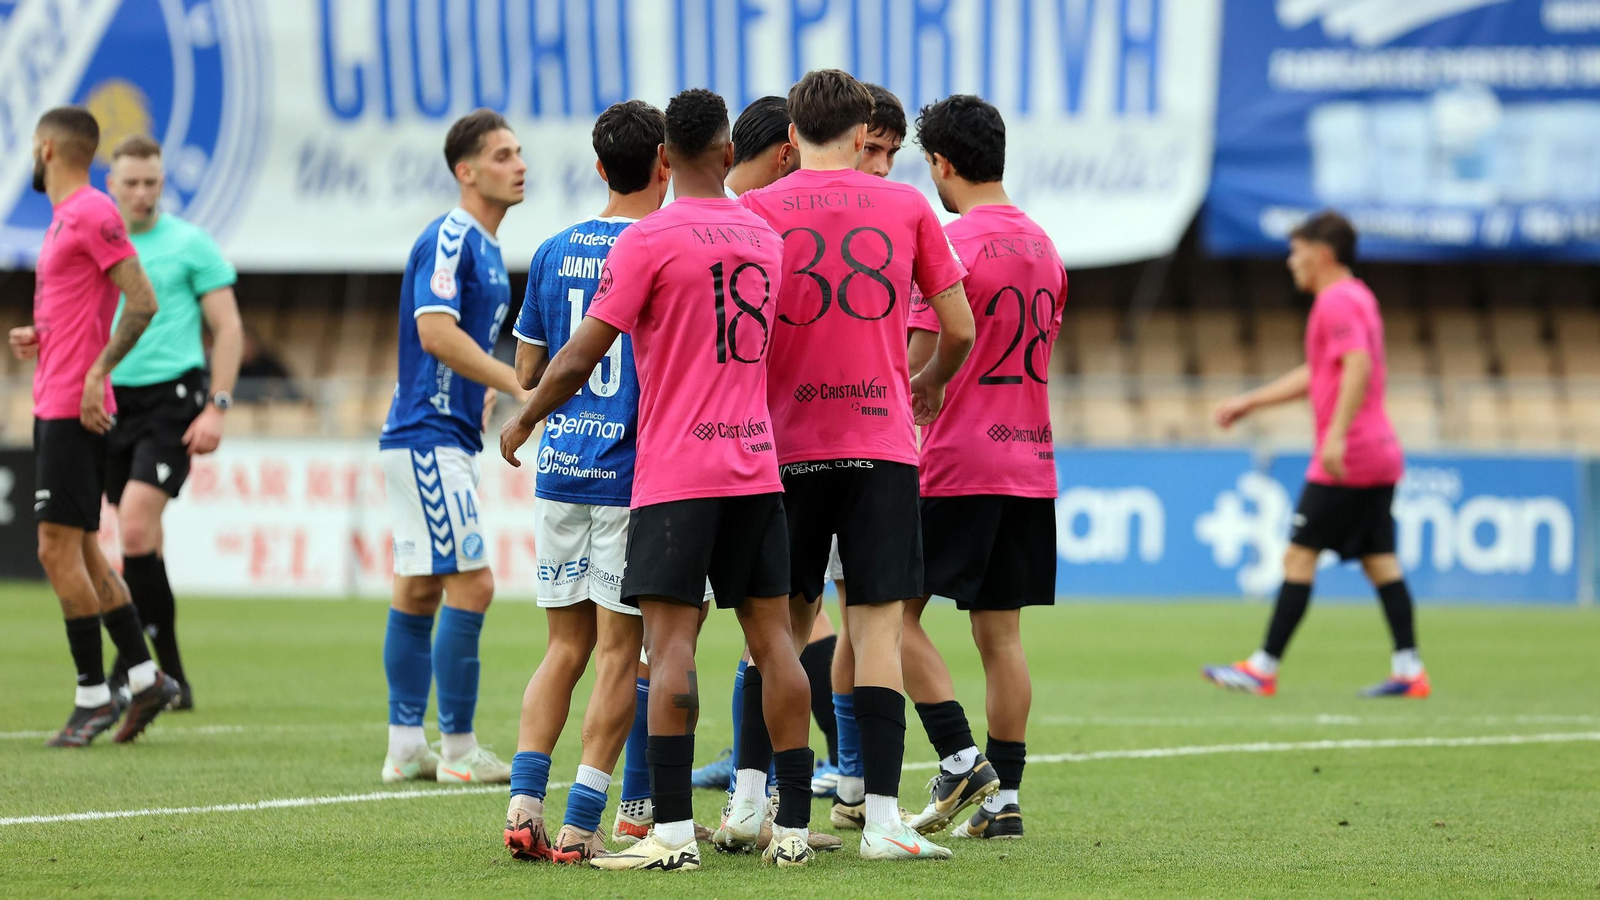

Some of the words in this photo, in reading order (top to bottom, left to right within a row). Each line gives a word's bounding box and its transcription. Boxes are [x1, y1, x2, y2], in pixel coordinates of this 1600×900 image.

[782, 192, 849, 211] SERGI
[778, 226, 897, 326] 38
[708, 261, 771, 364] 18
[978, 285, 1056, 385] 28
[551, 463, 617, 479] ProNutrition
[554, 450, 579, 465] High
[790, 463, 833, 476] DENTAL
[835, 459, 875, 469] CLINICS
[453, 488, 478, 527] 14
